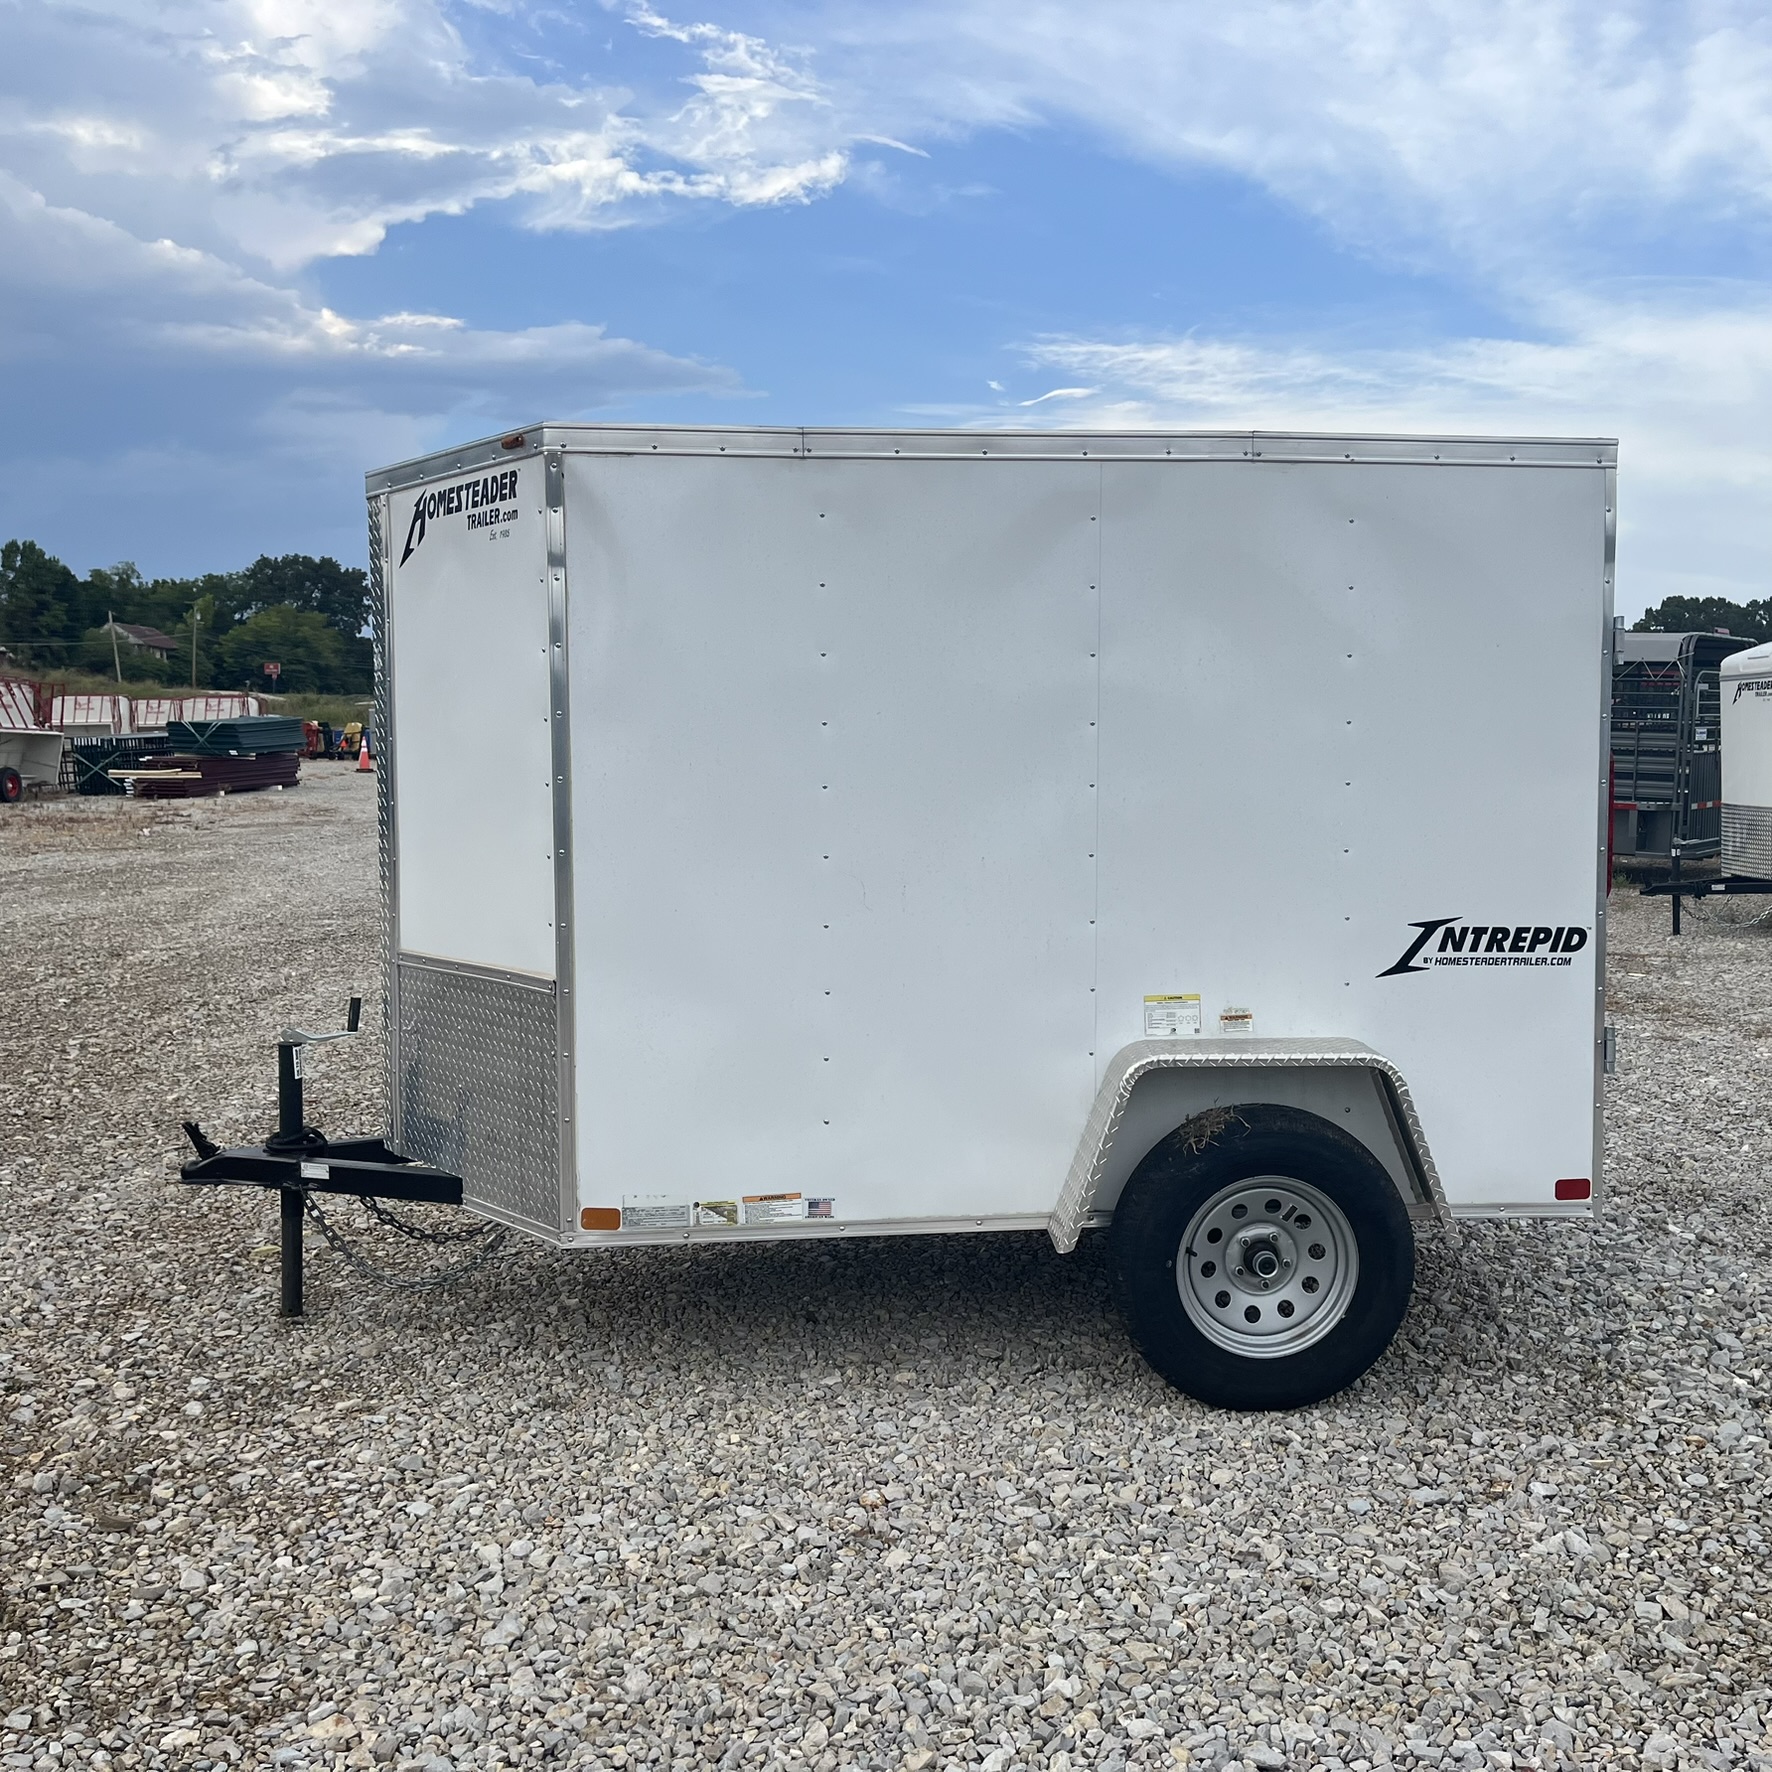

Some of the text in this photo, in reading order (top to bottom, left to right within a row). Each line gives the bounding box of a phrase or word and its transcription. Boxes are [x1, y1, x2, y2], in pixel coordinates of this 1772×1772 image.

[399, 469, 518, 568] HOMESTEADER
[467, 507, 519, 531] TRAILER.com
[1375, 916, 1588, 978] INTREPID
[1423, 956, 1572, 966] BY HOMESTEADERTRAILER.COM
